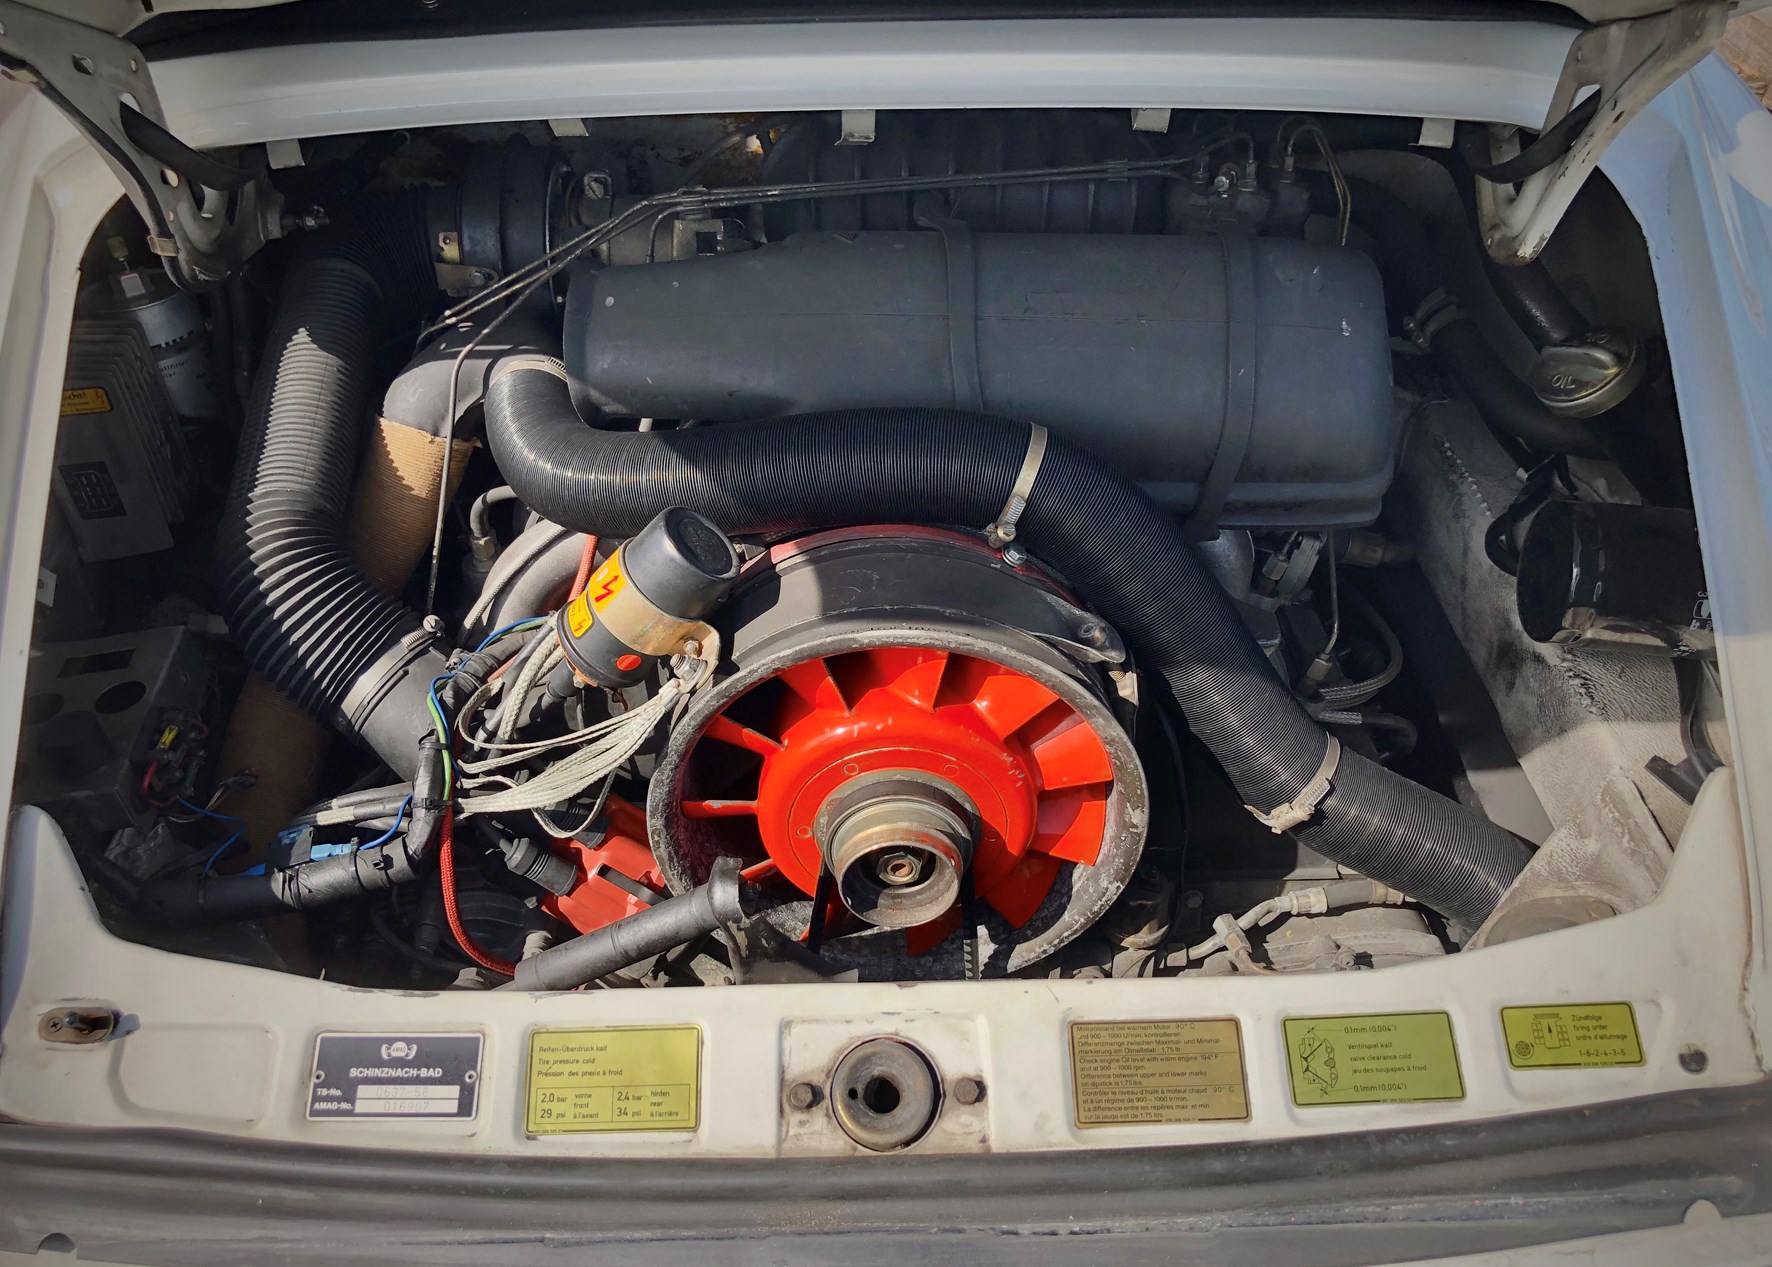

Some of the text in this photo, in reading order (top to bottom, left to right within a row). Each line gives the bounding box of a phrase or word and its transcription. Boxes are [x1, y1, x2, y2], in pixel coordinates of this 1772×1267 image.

[1552, 374, 1576, 389] OIL
[1348, 1042, 1378, 1050] Ventilspiel
[350, 1068, 442, 1078] SCHINZNACH-BAD
[317, 1088, 342, 1096] TS-No.
[617, 1091, 630, 1102] 2,4
[541, 1093, 554, 1104] 2,0
[314, 1102, 353, 1110] AMAG-No.
[540, 1108, 566, 1120] 29 psi
[617, 1107, 641, 1118] 34 psi
